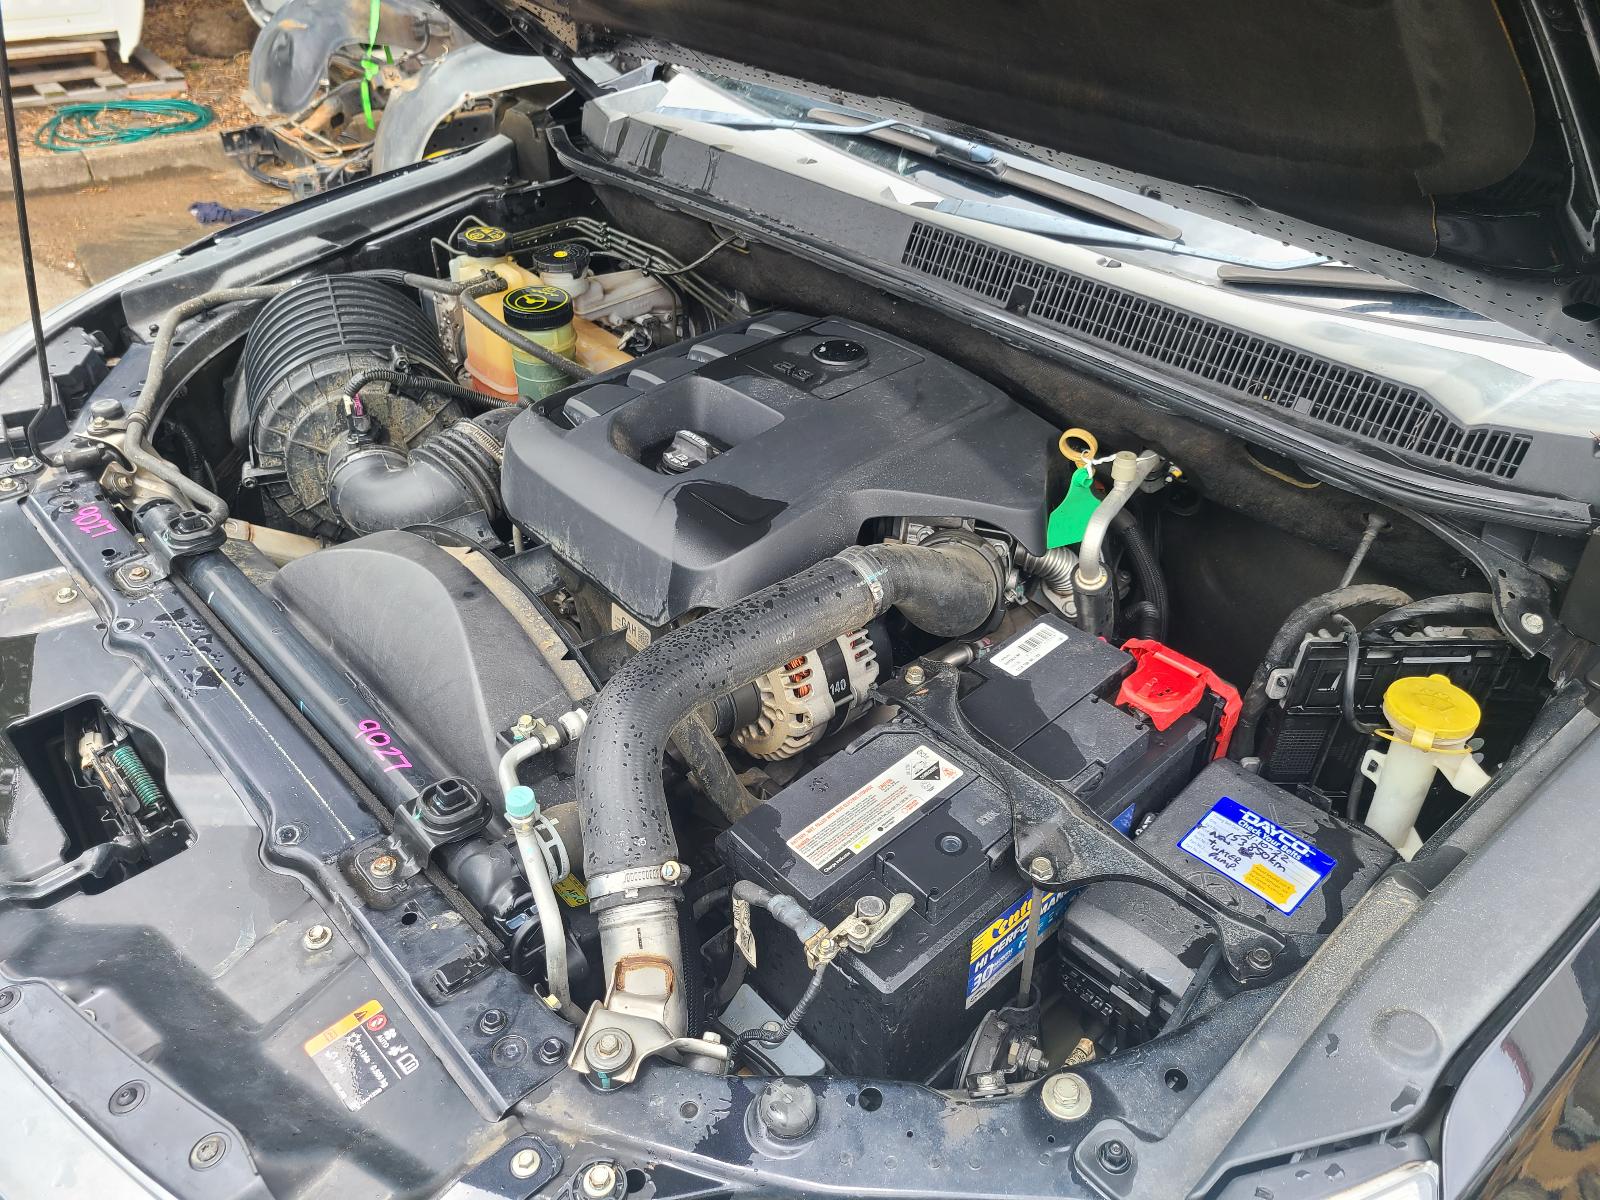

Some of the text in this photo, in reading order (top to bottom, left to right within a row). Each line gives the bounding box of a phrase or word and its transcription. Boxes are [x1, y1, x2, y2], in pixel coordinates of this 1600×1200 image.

[829, 678, 847, 695] 140
[355, 720, 413, 772] 9027
[1237, 818, 1262, 837] Check
[1261, 832, 1282, 848] Your
[1280, 843, 1302, 861] Belts
[1240, 809, 1310, 856] DAYCO
[971, 965, 996, 994] 30
[974, 956, 989, 974] HI
[376, 1034, 390, 1049] AUTO
